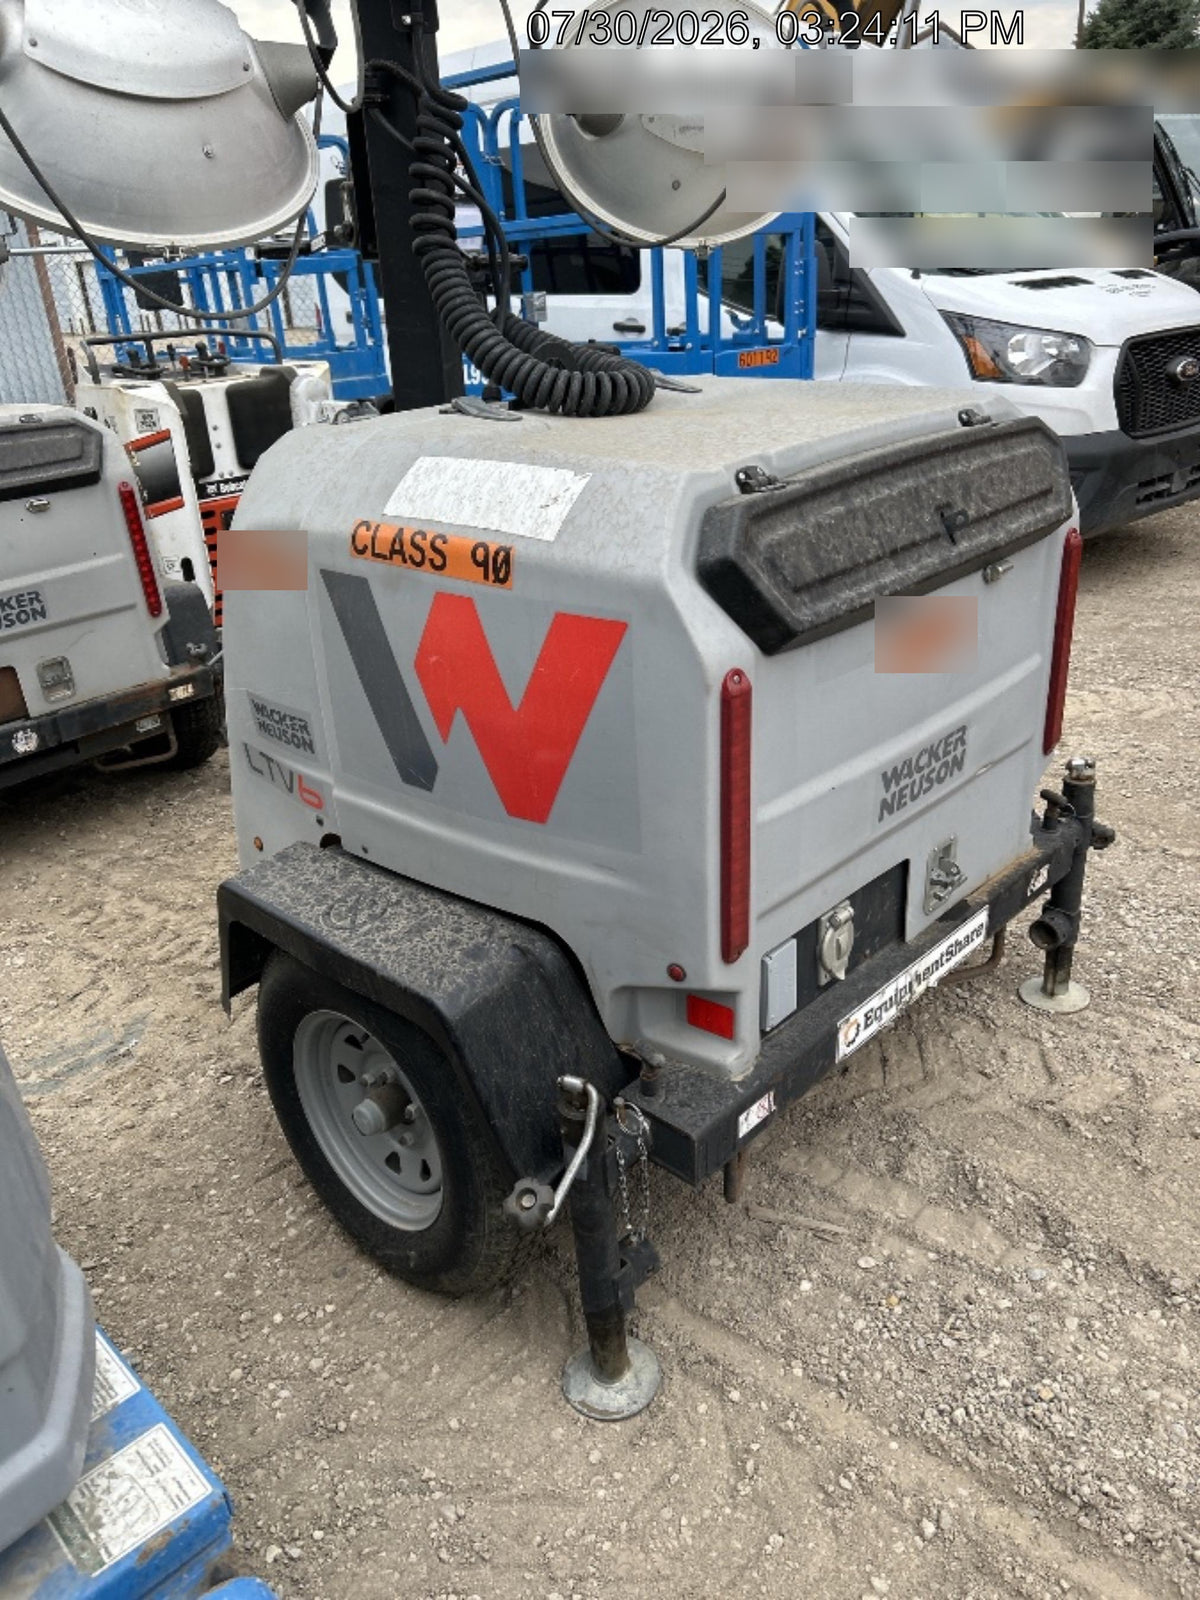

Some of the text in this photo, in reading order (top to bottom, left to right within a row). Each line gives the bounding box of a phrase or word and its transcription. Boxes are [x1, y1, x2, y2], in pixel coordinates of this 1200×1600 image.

[351, 520, 448, 572] CLASS
[0, 605, 47, 630] SON
[250, 698, 311, 737] WACKER
[256, 717, 315, 755] NEUSON
[881, 724, 967, 794] WACKER
[878, 747, 967, 824] NEUSON
